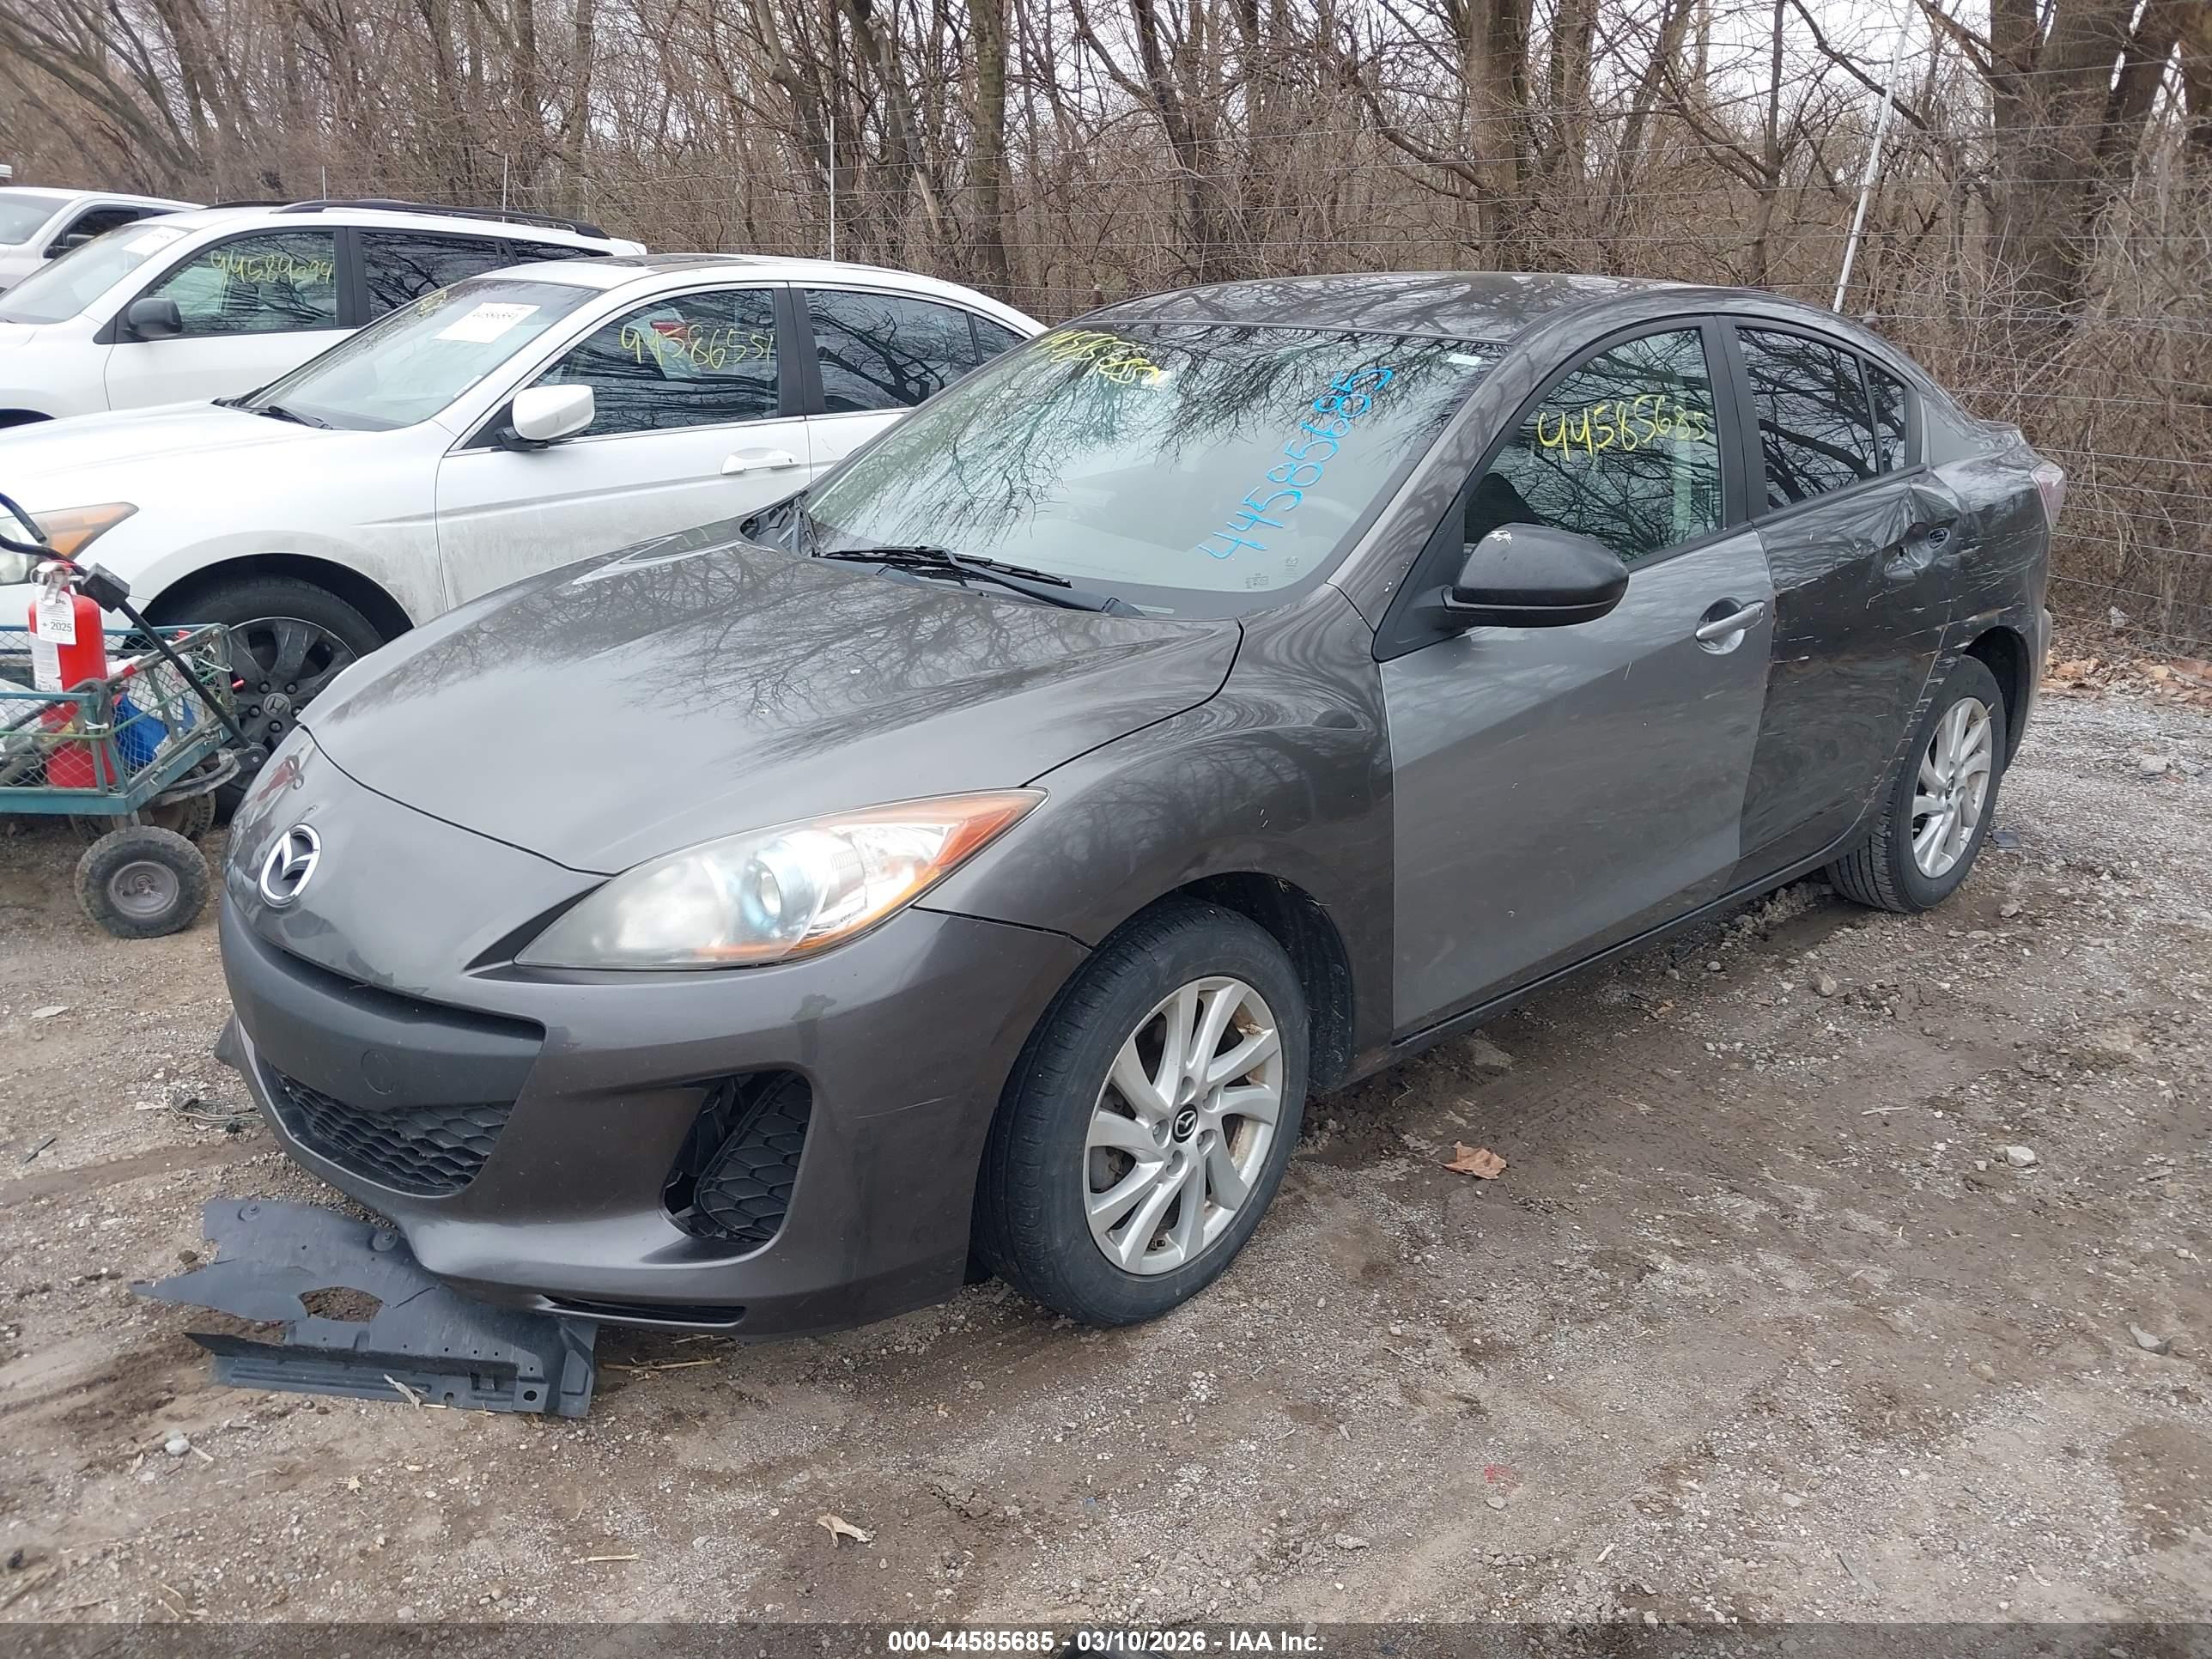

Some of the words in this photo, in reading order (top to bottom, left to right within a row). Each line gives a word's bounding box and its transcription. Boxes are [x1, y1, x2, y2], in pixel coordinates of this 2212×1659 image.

[1538, 394, 1709, 461] 44585685
[1198, 368, 1394, 559] 44585685
[50, 622, 72, 632] 2025
